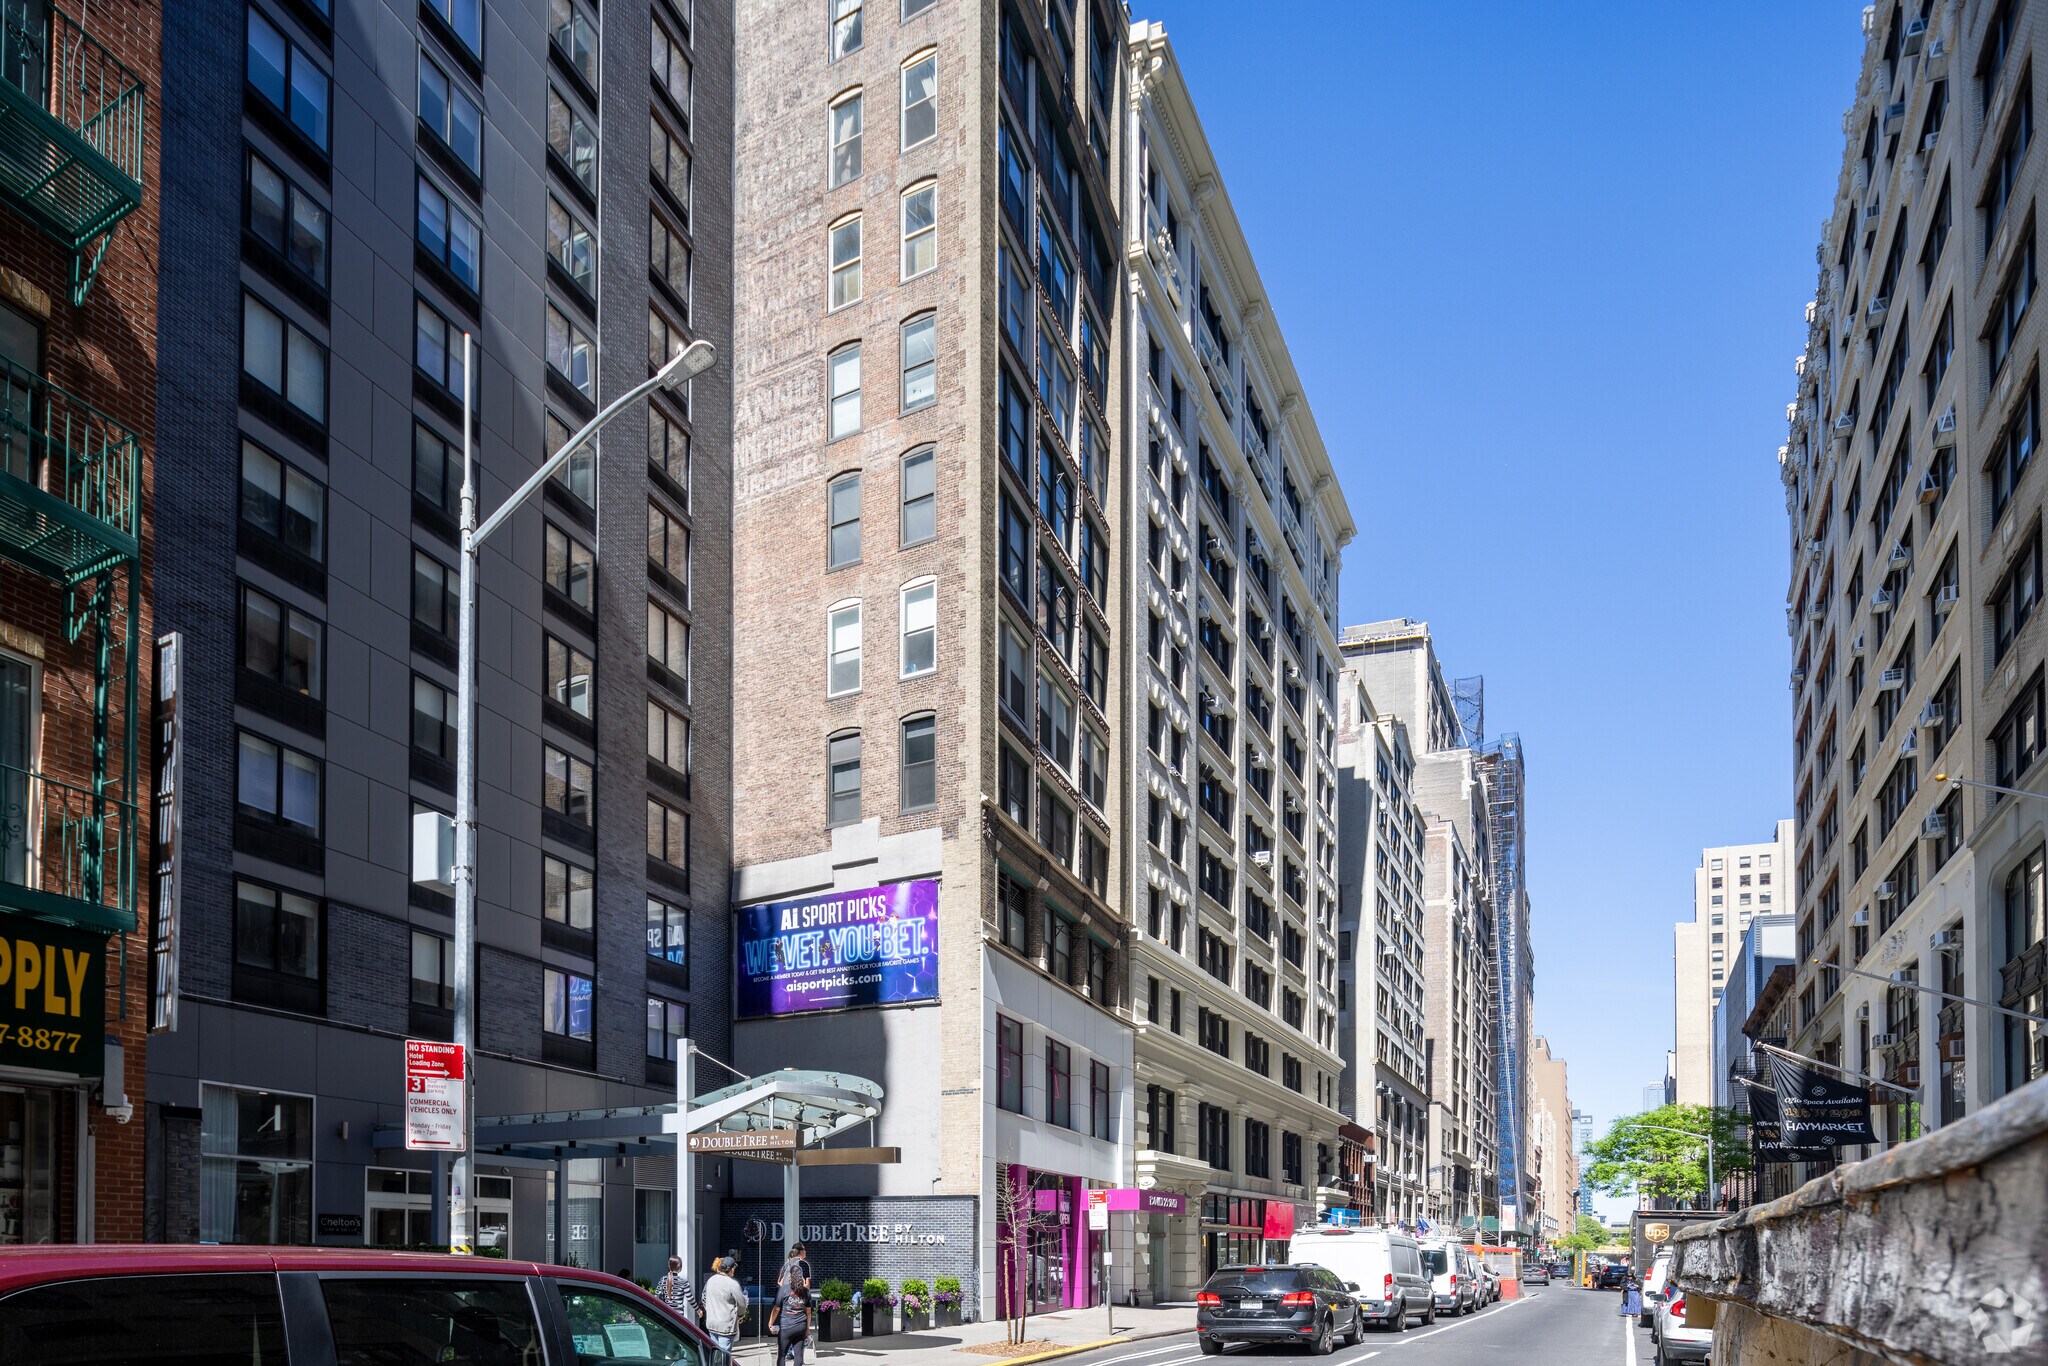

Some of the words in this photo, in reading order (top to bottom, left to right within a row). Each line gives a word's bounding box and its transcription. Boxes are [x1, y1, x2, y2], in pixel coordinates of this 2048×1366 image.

[802, 901, 843, 928] SPORT
[847, 895, 886, 922] PICKS
[745, 937, 778, 975] WE
[782, 930, 828, 970] VET.
[830, 924, 875, 964] YOU
[880, 917, 929, 959] BET.
[753, 975, 770, 983] BECOME
[836, 965, 859, 973] ANALYTICS
[786, 972, 882, 993] aisportpicks.com
[409, 1044, 419, 1052] NO
[421, 1044, 455, 1054] STANDING
[409, 1059, 430, 1067] Loading
[411, 1078, 421, 1091] 3
[410, 1098, 450, 1107] COMMERCIAL
[1825, 1096, 1863, 1105] Available
[410, 1106, 440, 1114] VEHICLES
[441, 1107, 457, 1115] ONLY
[1786, 1122, 1864, 1131] HAYMARKET
[724, 1150, 775, 1161] OUBLETREE
[1060, 1201, 1070, 1212] NOW
[320, 1217, 361, 1227] Chelton's
[1060, 1213, 1070, 1225] OPEN
[771, 1222, 890, 1243] DUBLETREE
[895, 1223, 913, 1233] BY
[1646, 1228, 1668, 1239] ups
[895, 1234, 945, 1245] HILTON
